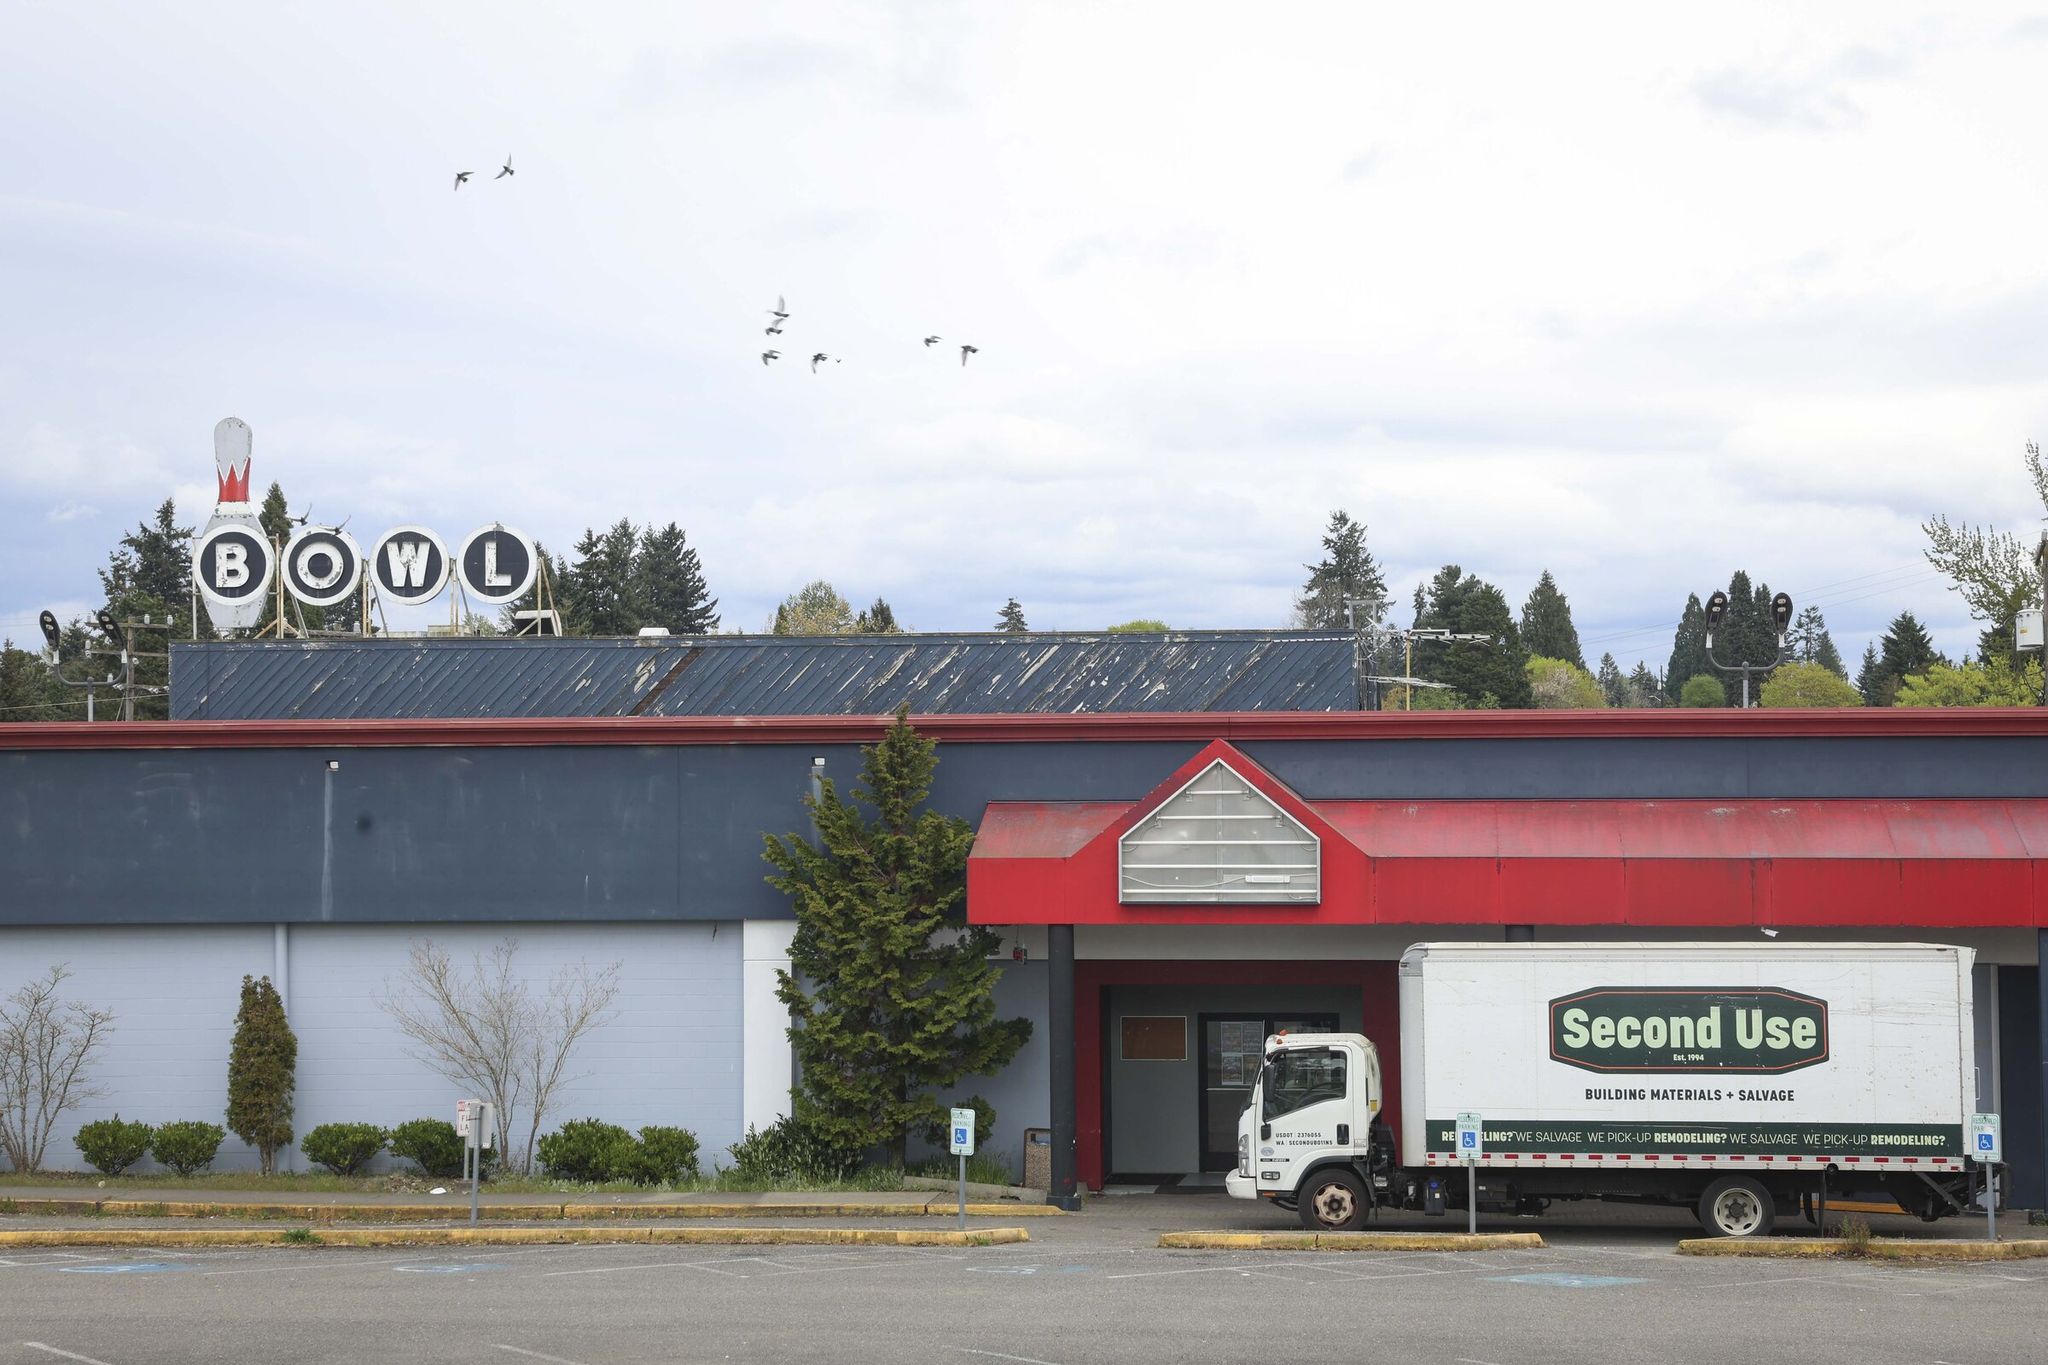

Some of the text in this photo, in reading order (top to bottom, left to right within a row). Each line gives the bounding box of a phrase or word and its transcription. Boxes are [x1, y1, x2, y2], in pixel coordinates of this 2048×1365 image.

[215, 541, 512, 589] BOWL
[1562, 1006, 1818, 1050] Second Use
[1673, 1053, 1705, 1062] Est. 1994
[1585, 1088, 1795, 1102] BUILDING MATERIALS + SALVAGE
[1516, 1131, 1533, 1143] WE
[1535, 1131, 1582, 1143] SALVAGE
[1587, 1132, 1604, 1143] WE
[1607, 1132, 1652, 1143] PICK-UP
[1654, 1132, 1727, 1144] REMODELING?
[1729, 1133, 1747, 1145] WE
[1750, 1133, 1798, 1145] SALVAGE
[1803, 1133, 1821, 1145] WE
[1823, 1134, 1867, 1145] PICK-UP
[1870, 1134, 1946, 1146] REMODELING?
